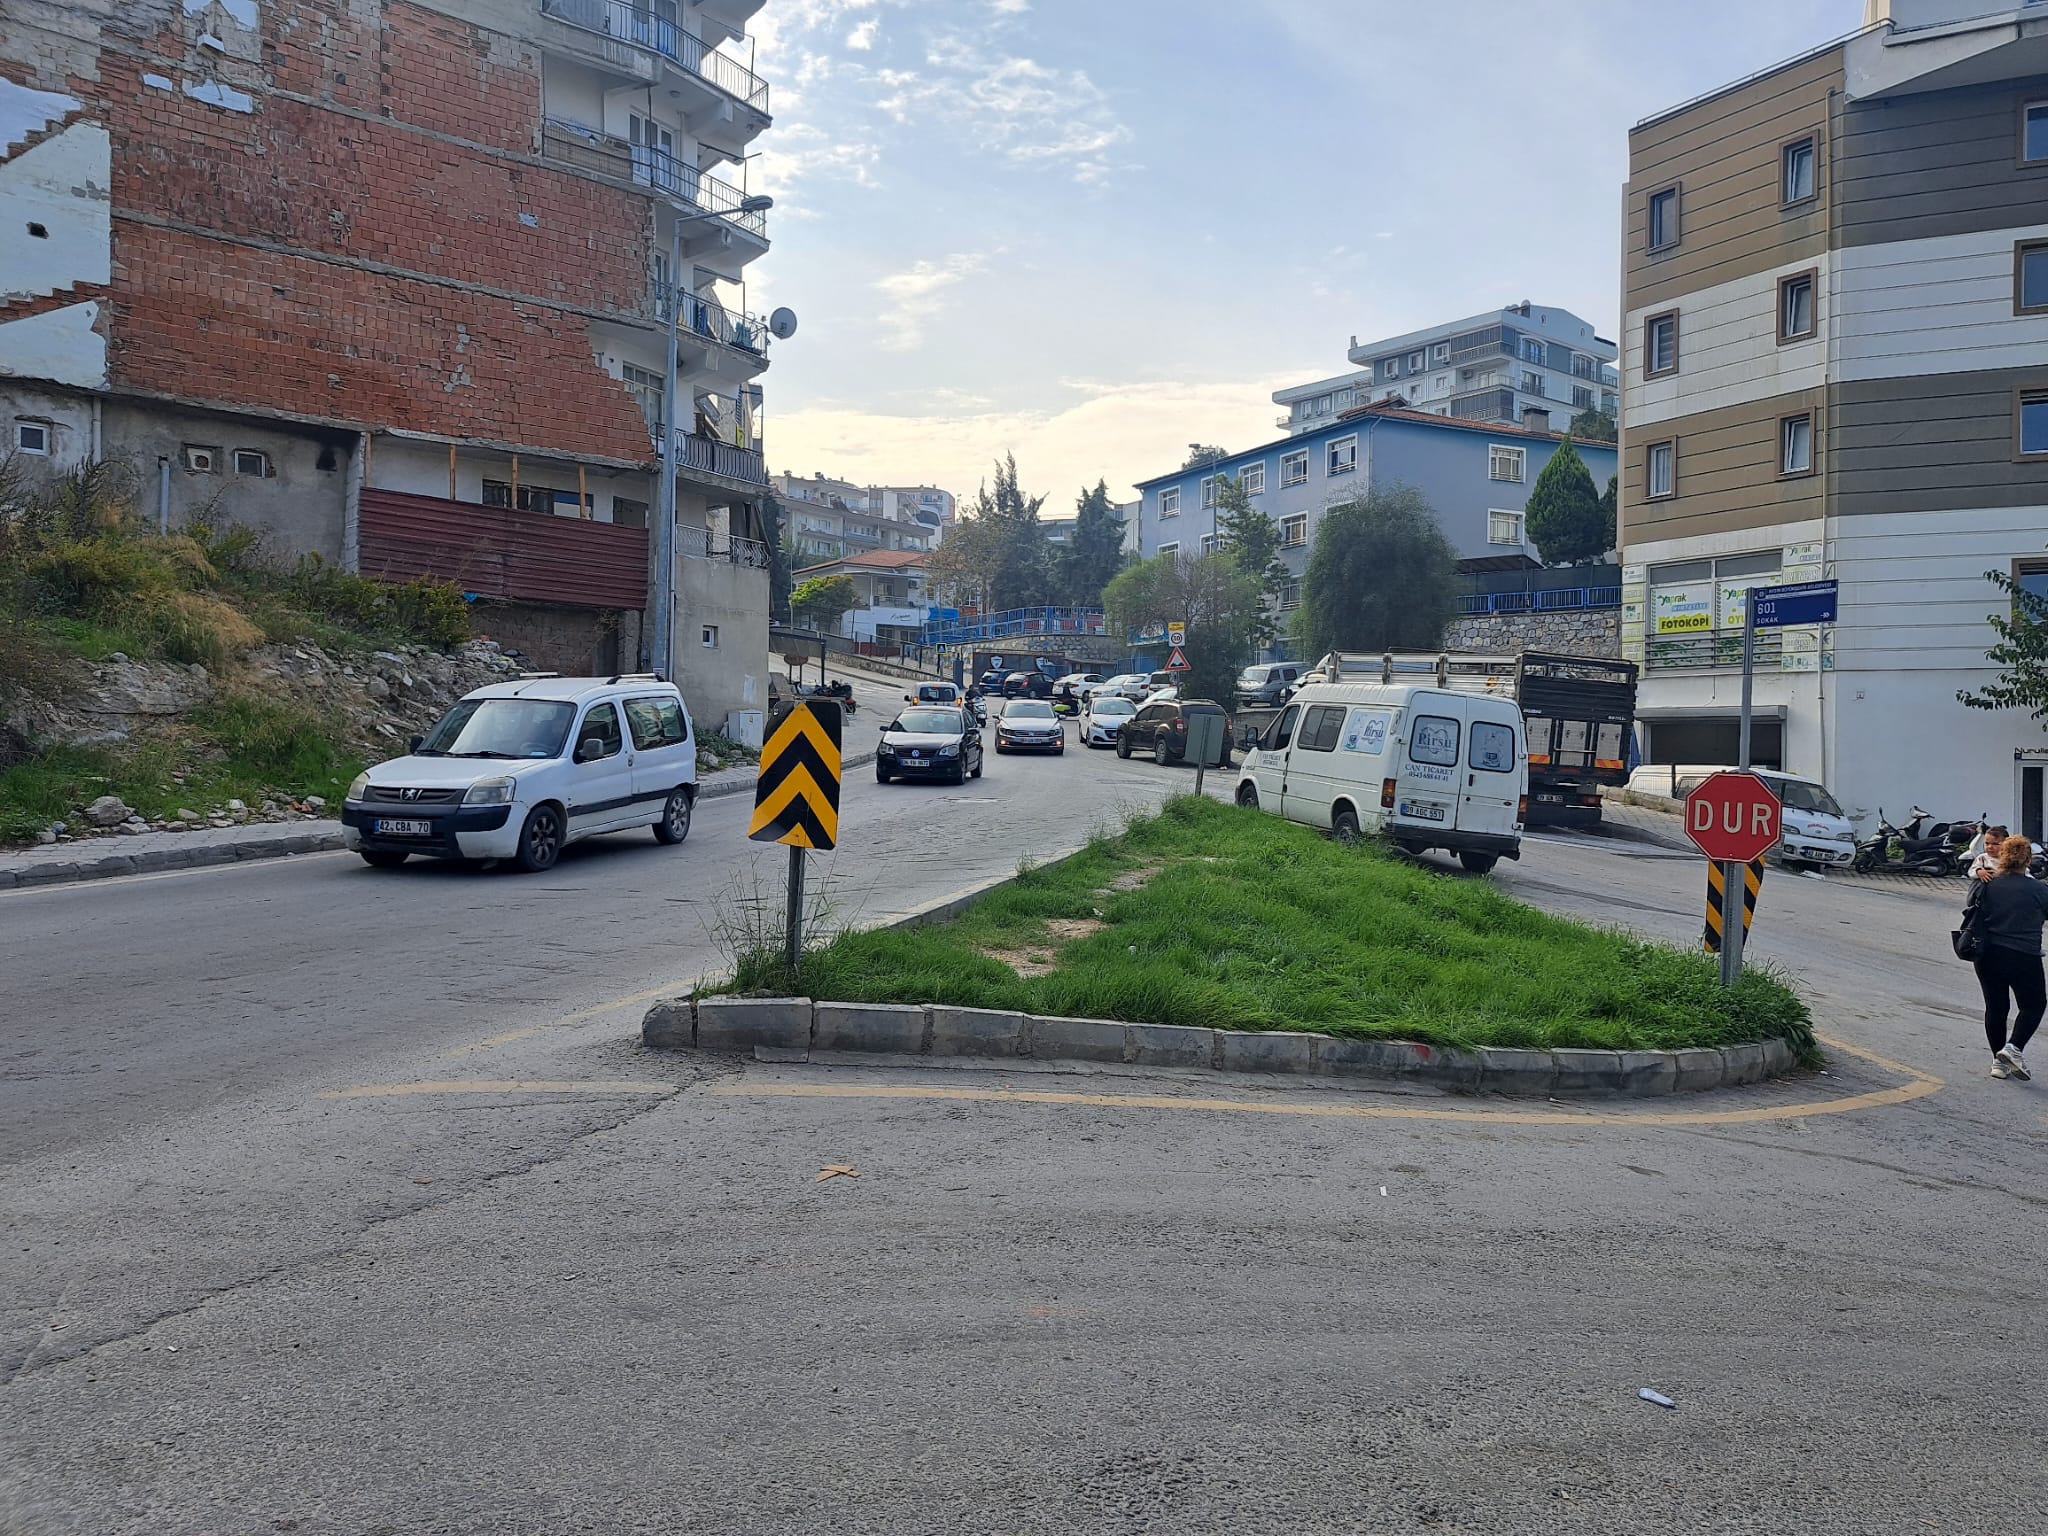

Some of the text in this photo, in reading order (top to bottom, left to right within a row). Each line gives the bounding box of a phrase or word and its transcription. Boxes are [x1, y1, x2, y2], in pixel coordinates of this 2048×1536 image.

[1657, 592, 1687, 606] yaprak
[1757, 602, 1776, 615] 601
[1661, 614, 1709, 629] FOTOKOPİ
[1756, 616, 1779, 625] SOKAK
[1694, 799, 1773, 837] DUR
[395, 822, 412, 832] CBA
[418, 822, 429, 832] 70
